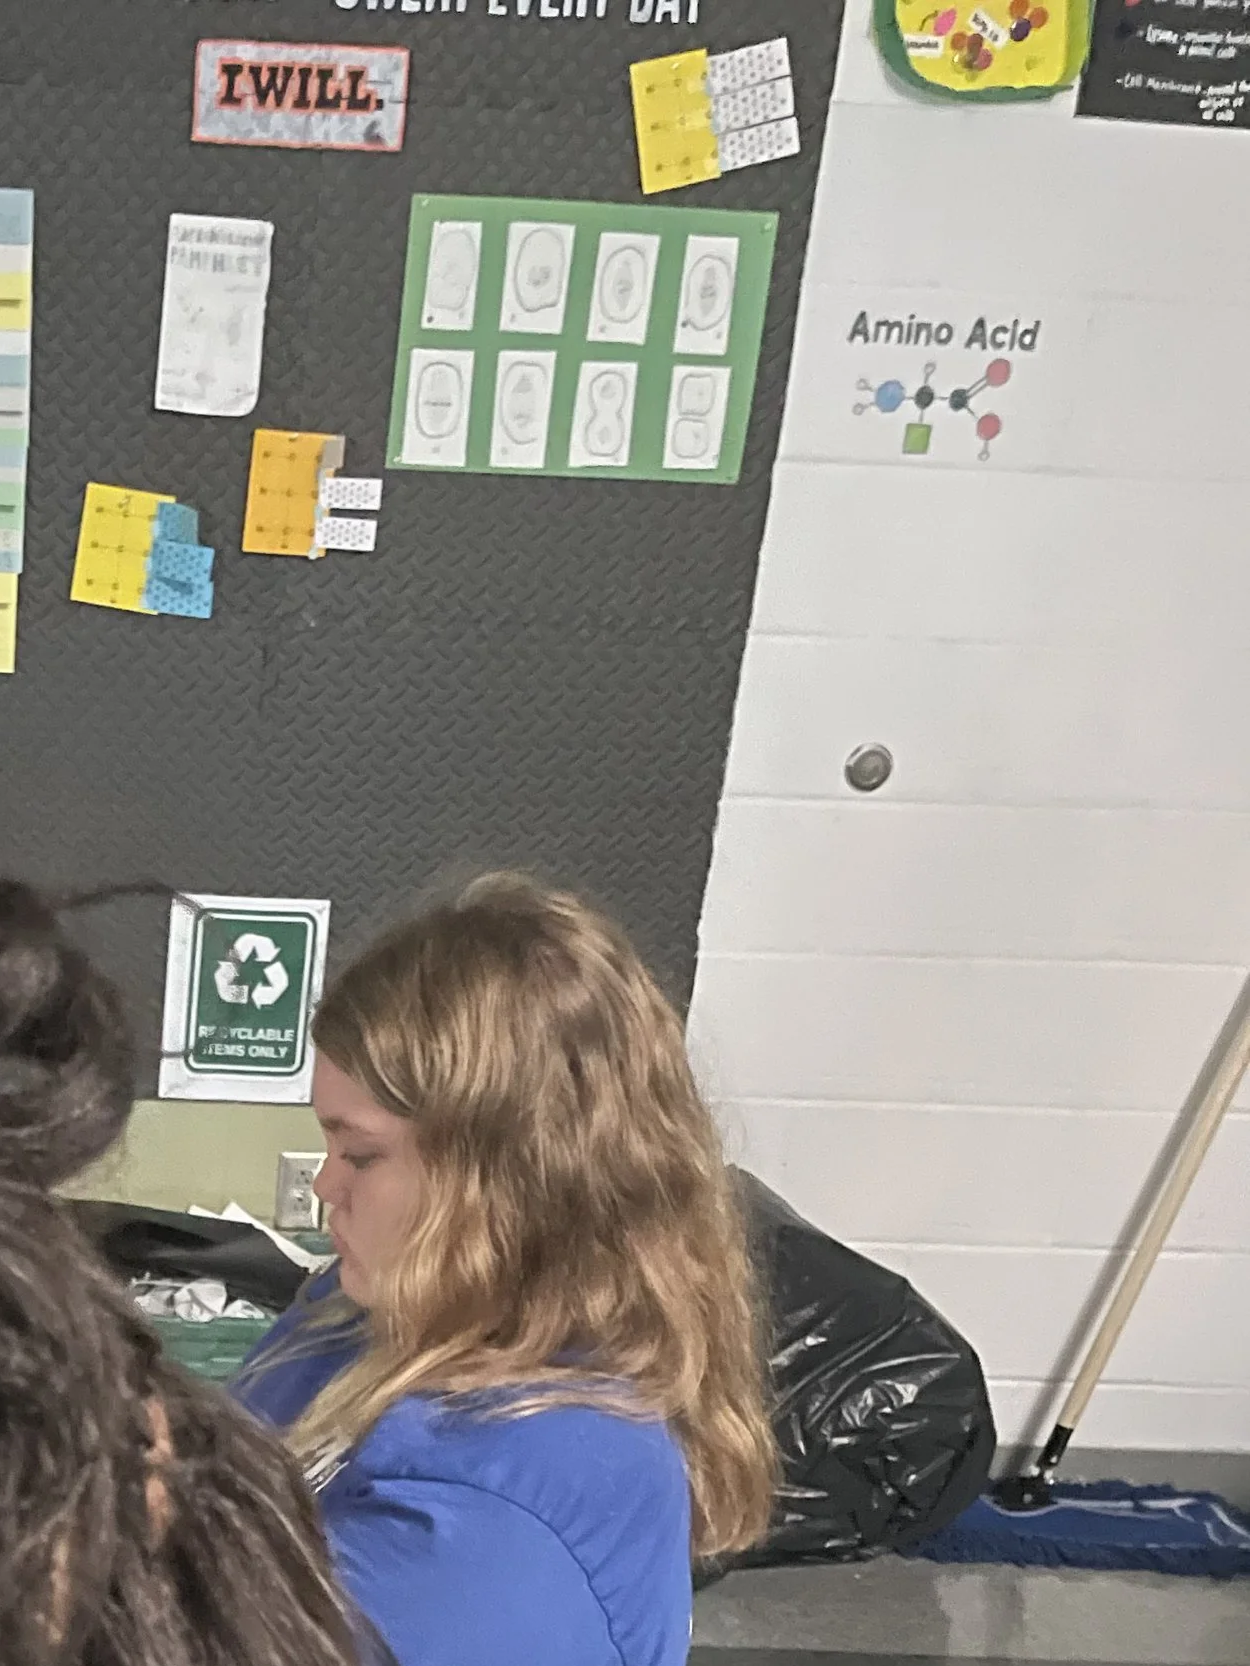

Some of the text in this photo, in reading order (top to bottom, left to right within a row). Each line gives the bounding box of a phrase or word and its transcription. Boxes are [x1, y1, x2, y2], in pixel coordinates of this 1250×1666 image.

[846, 310, 1042, 352] Amino Acid
[248, 1045, 289, 1059] ONLY
